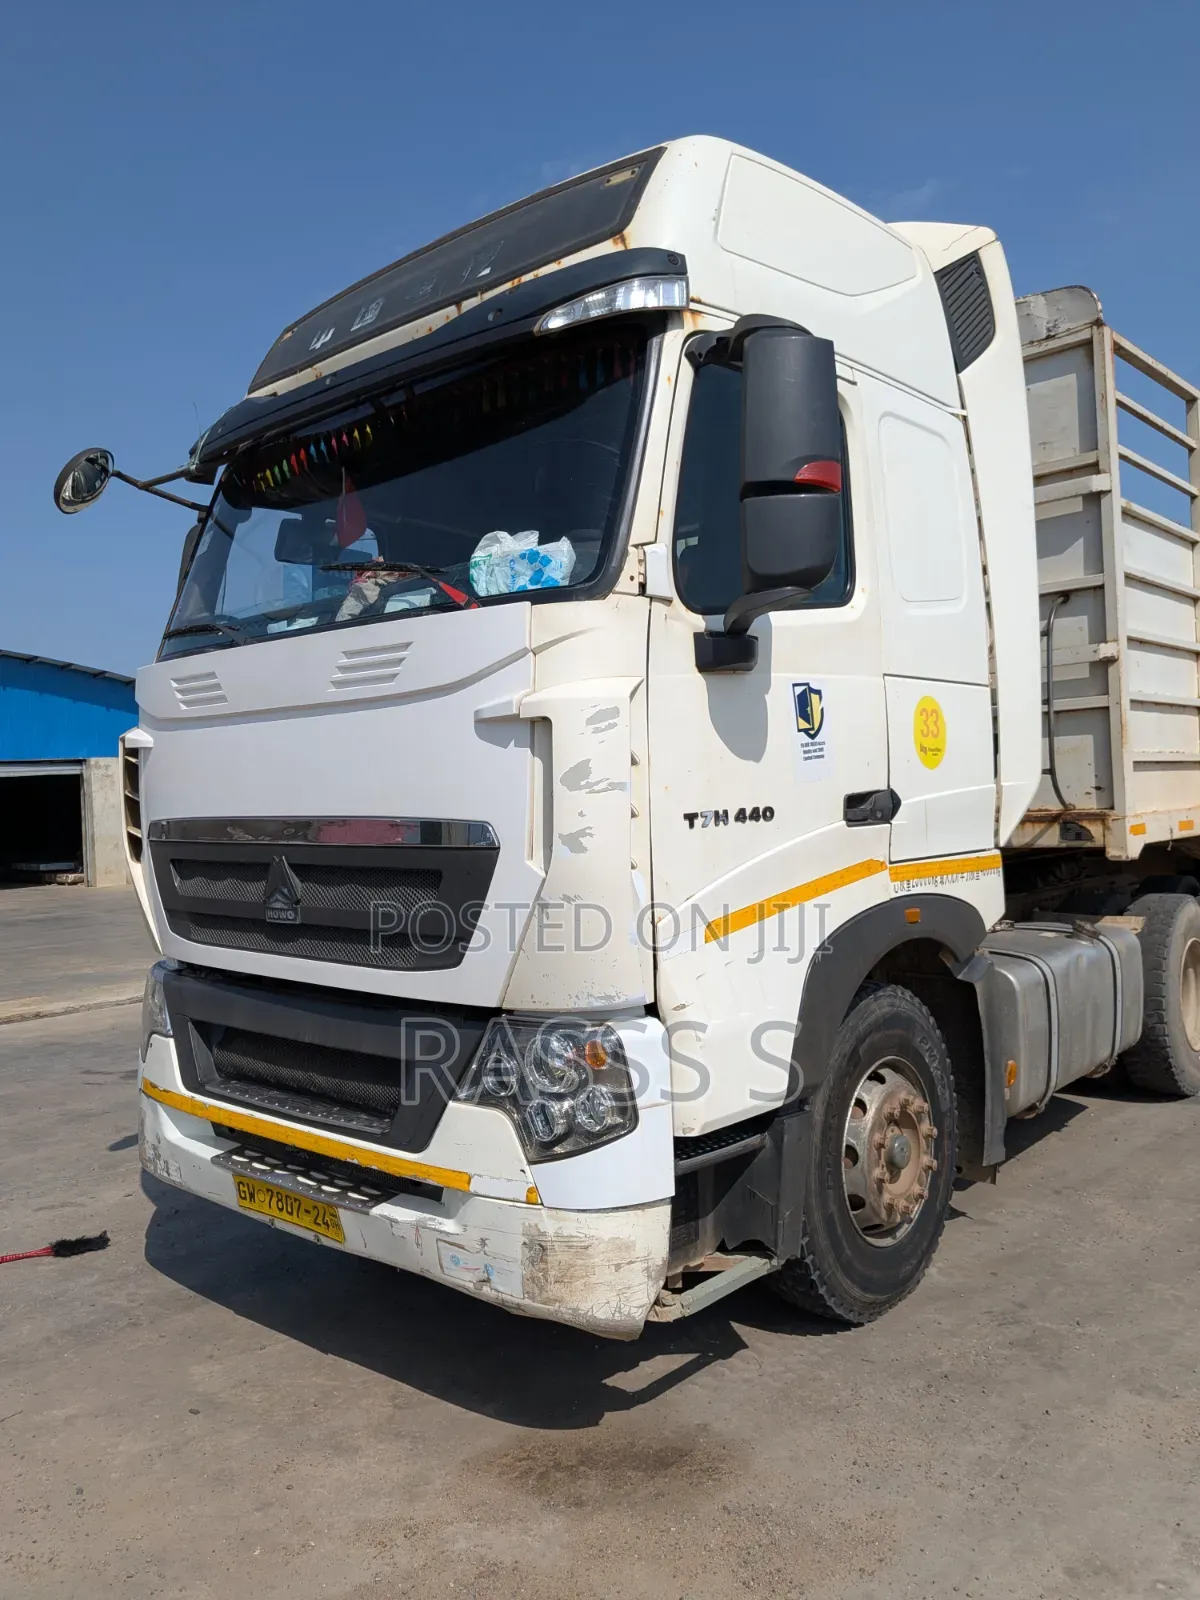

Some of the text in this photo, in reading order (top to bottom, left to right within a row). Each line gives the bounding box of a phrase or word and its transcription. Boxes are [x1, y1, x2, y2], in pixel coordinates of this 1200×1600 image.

[920, 707, 940, 738] 33
[683, 806, 775, 830] T7H 440
[267, 908, 295, 920] HOWO
[237, 1181, 256, 1203] GW
